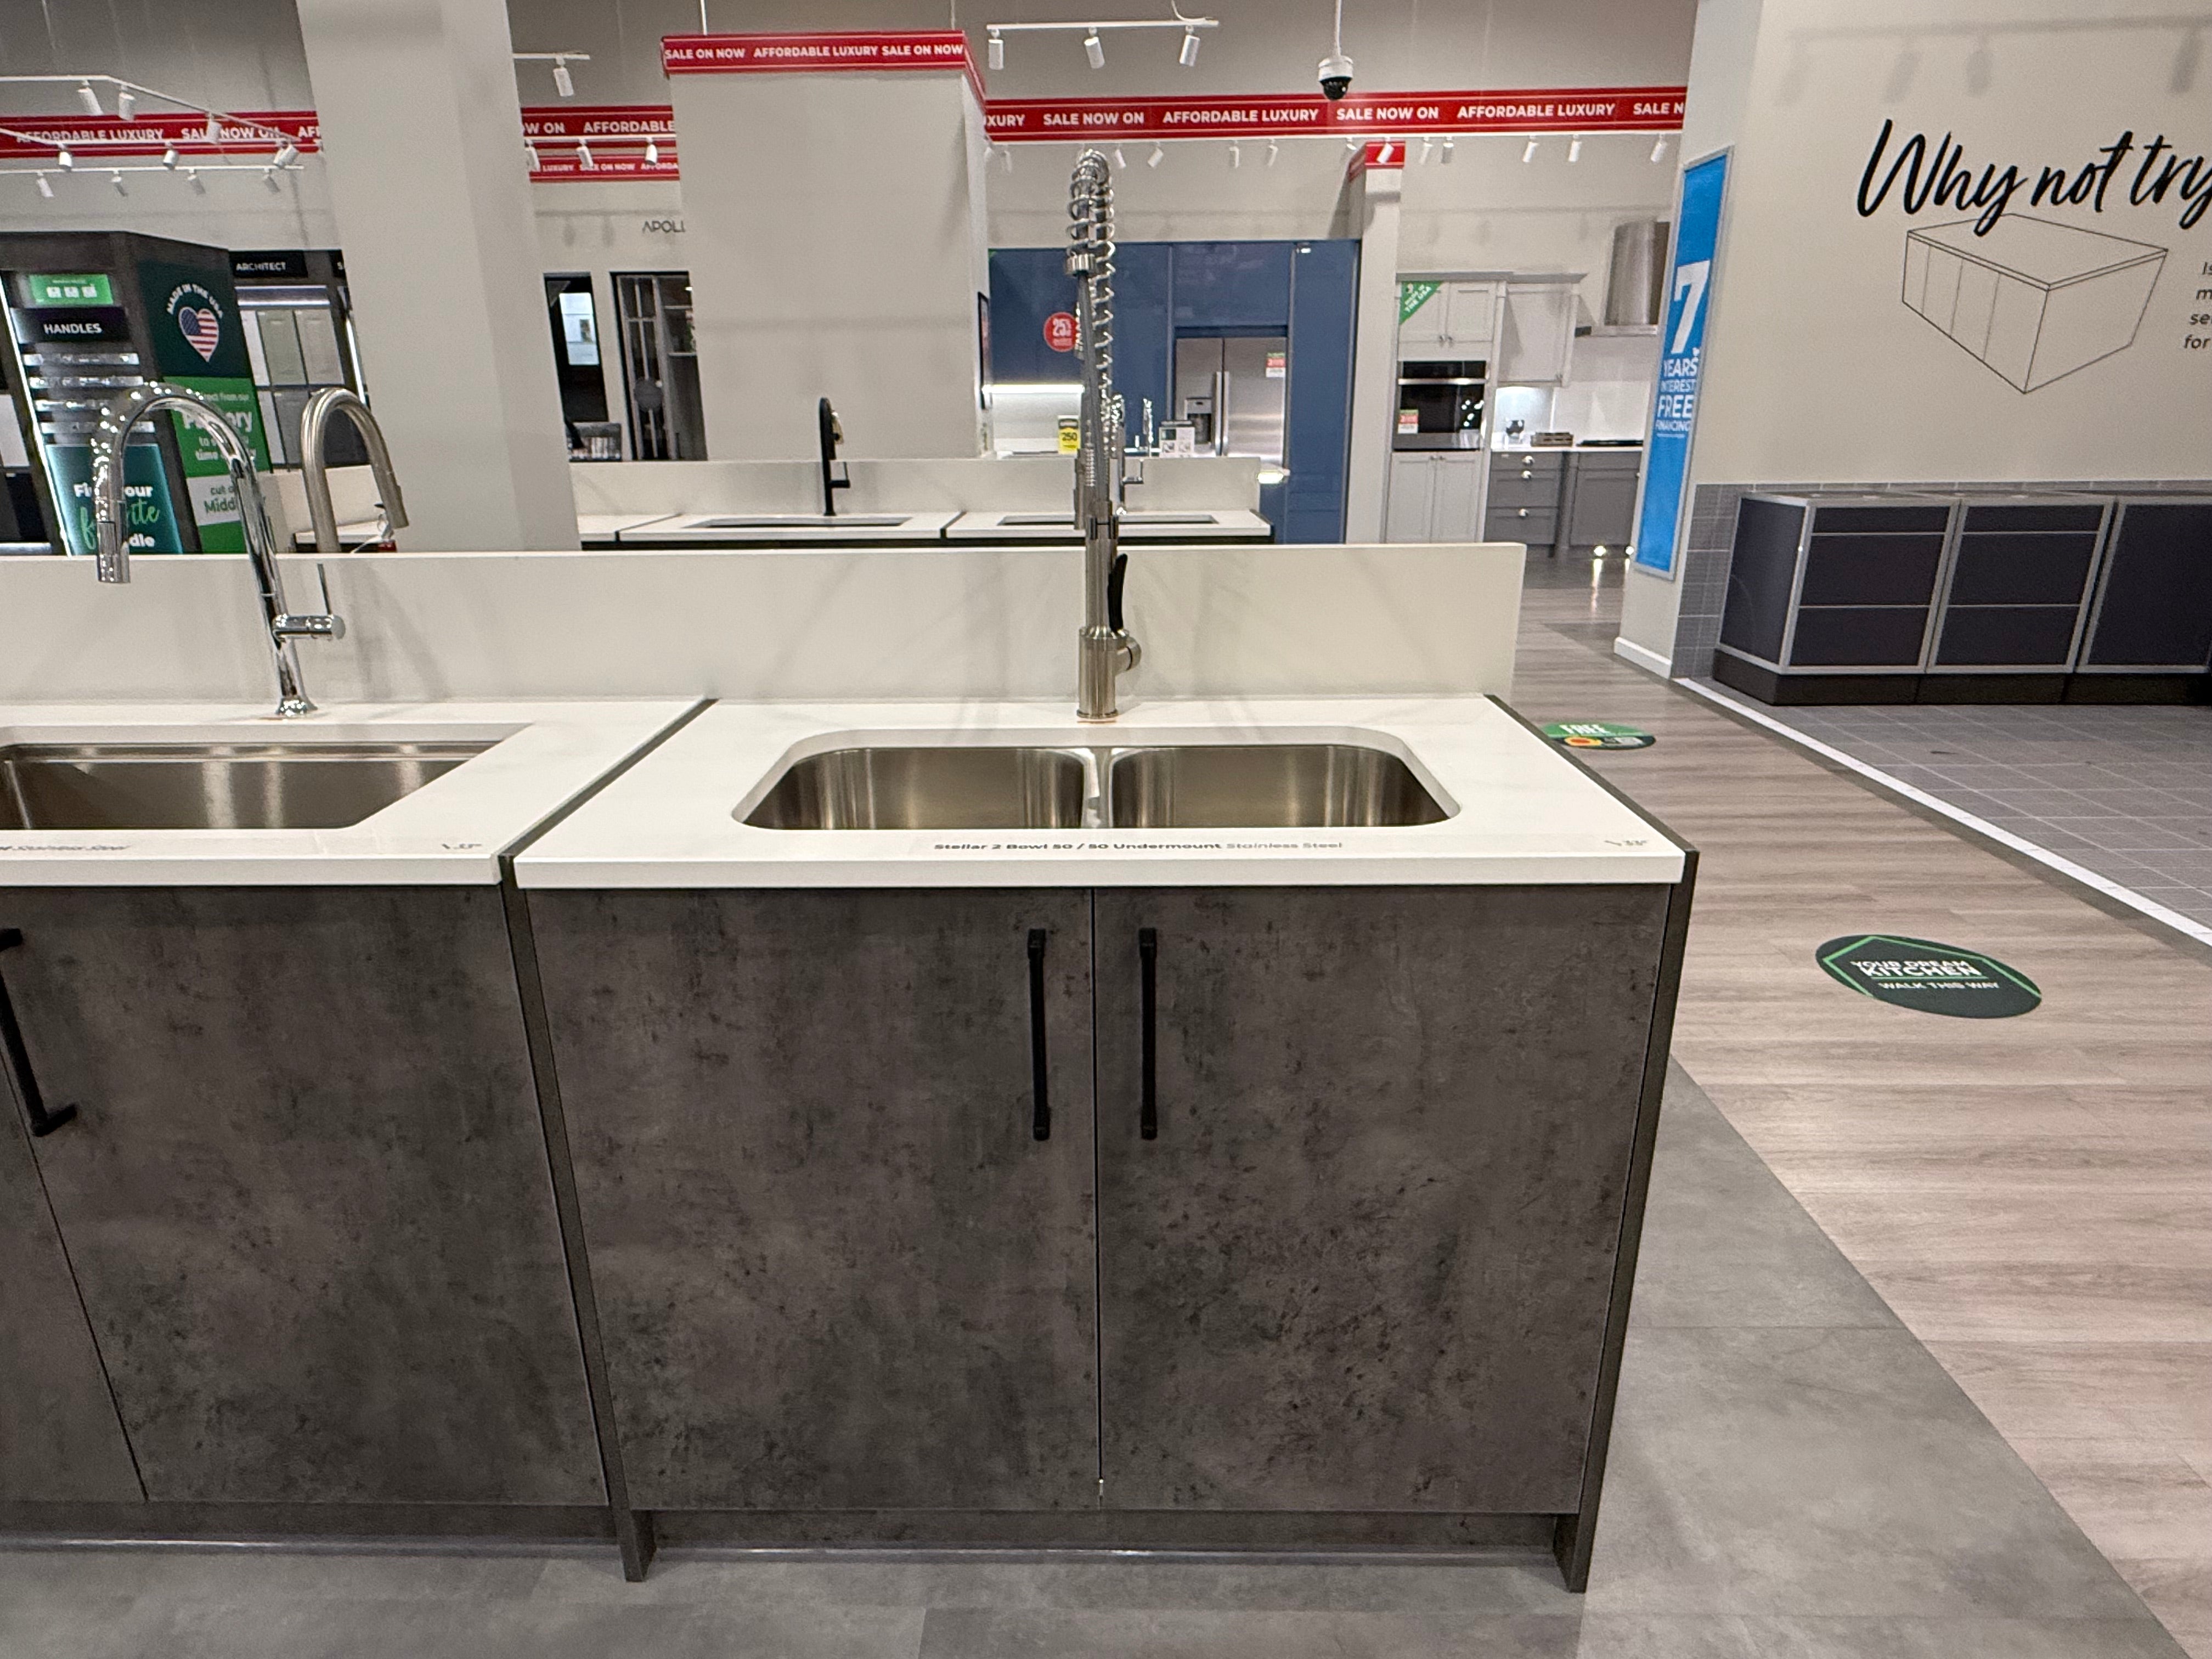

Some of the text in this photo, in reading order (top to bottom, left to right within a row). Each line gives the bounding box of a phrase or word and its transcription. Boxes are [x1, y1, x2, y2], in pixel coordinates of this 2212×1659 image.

[664, 44, 964, 59] SALE ON NOW AFFORDABLE LUXURY SALE ON NOW
[1043, 113, 1079, 125] SALE
[1082, 112, 1119, 125] NOW
[1122, 111, 1144, 124] ON
[1163, 110, 1259, 123] AFFORDABLE
[1261, 109, 1318, 122] LUXURY
[1336, 108, 1373, 120] SALE
[1376, 107, 1413, 120] NOW
[1417, 106, 1439, 119] ON
[1457, 104, 1554, 119] AFFORDABLE
[1558, 103, 1615, 116] LUXURY
[1633, 102, 1669, 115] SALE
[110, 128, 163, 140] LUXURY
[180, 127, 209, 139] SAL
[221, 127, 254, 138] NOW
[543, 122, 565, 134] ON
[583, 120, 675, 133] AFFORDABLE
[1857, 119, 2212, 237] Why not try
[236, 262, 286, 271] ARCHITECT
[1671, 259, 1711, 354] 7
[2190, 313, 2212, 325] se
[43, 323, 103, 335] HANDLES
[2183, 334, 2211, 349] for
[1657, 394, 1695, 418] FREE
[124, 486, 154, 497] our
[1858, 965, 1983, 977] KITCHEN
